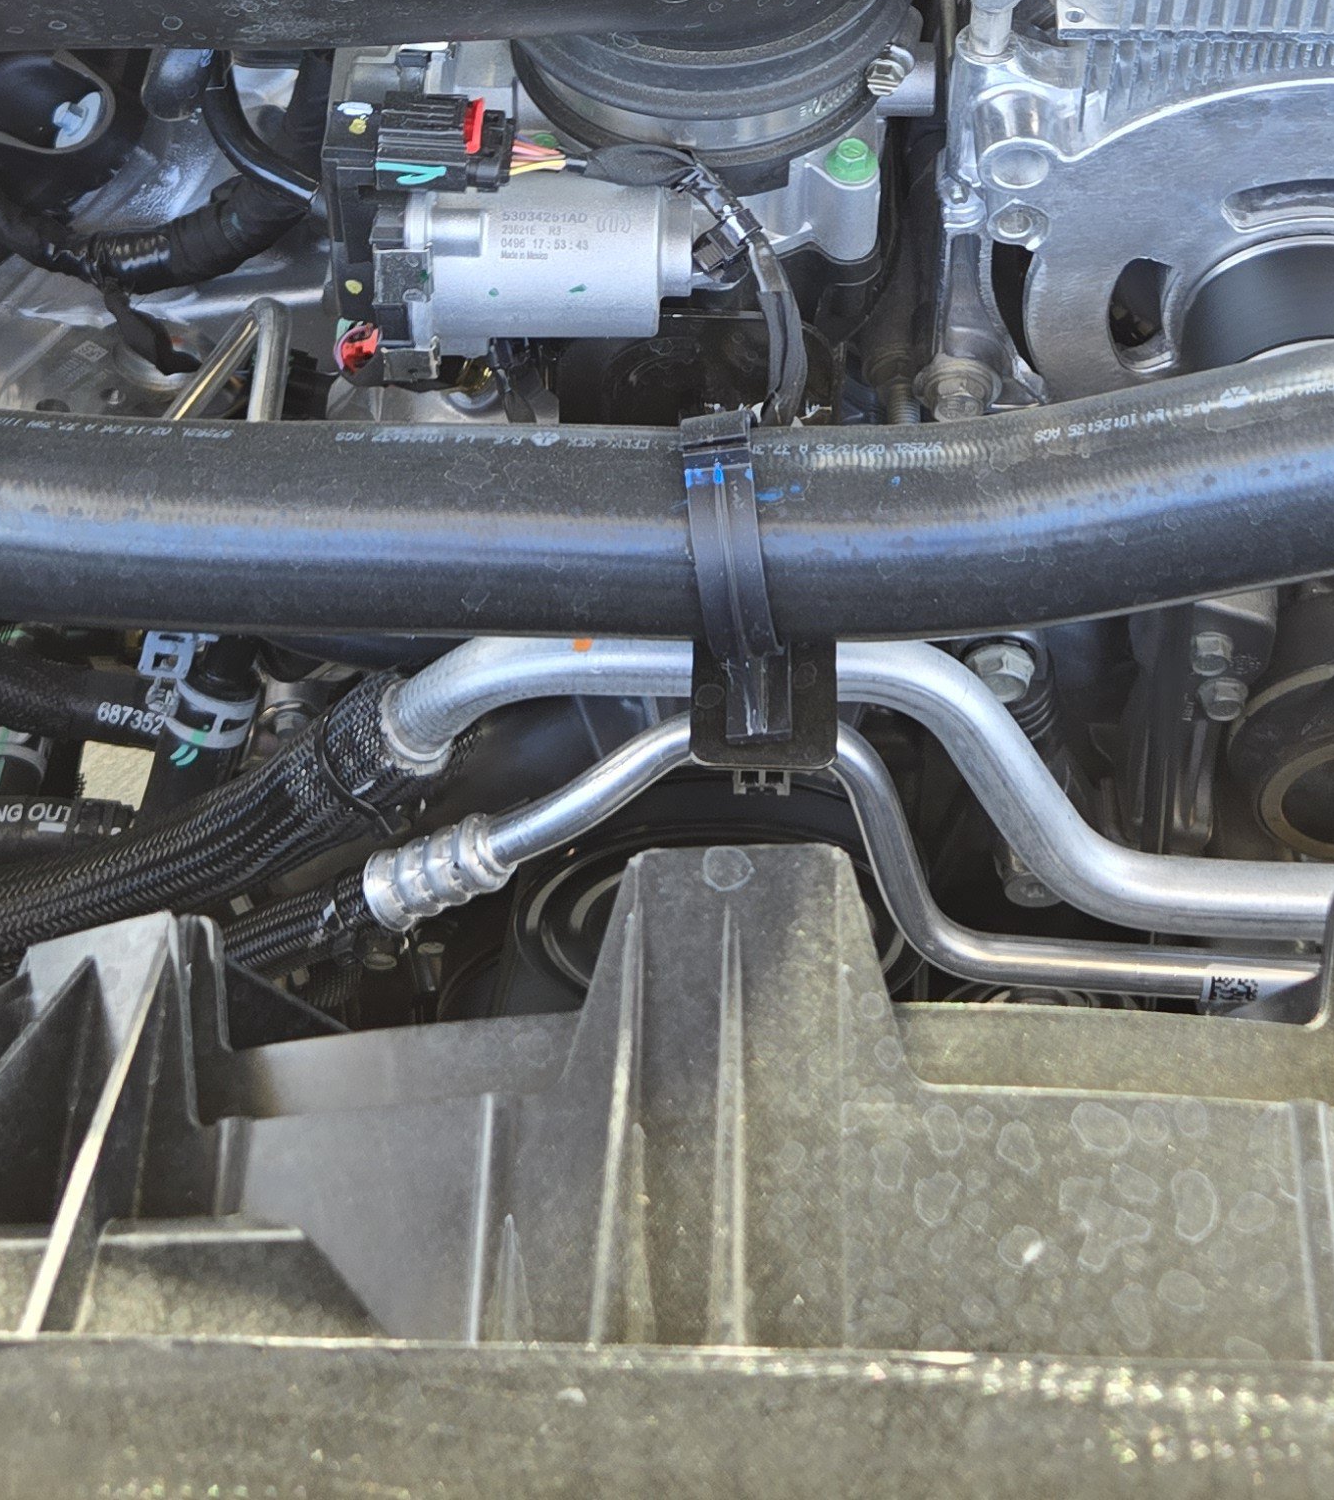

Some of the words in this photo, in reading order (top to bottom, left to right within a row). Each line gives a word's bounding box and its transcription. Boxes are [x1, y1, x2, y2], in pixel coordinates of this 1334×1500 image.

[1065, 412, 1137, 437] 10:26:35
[334, 432, 365, 441] AGS
[1032, 425, 1062, 443] AGS
[798, 444, 808, 452] A
[815, 443, 885, 456] 02/13/26
